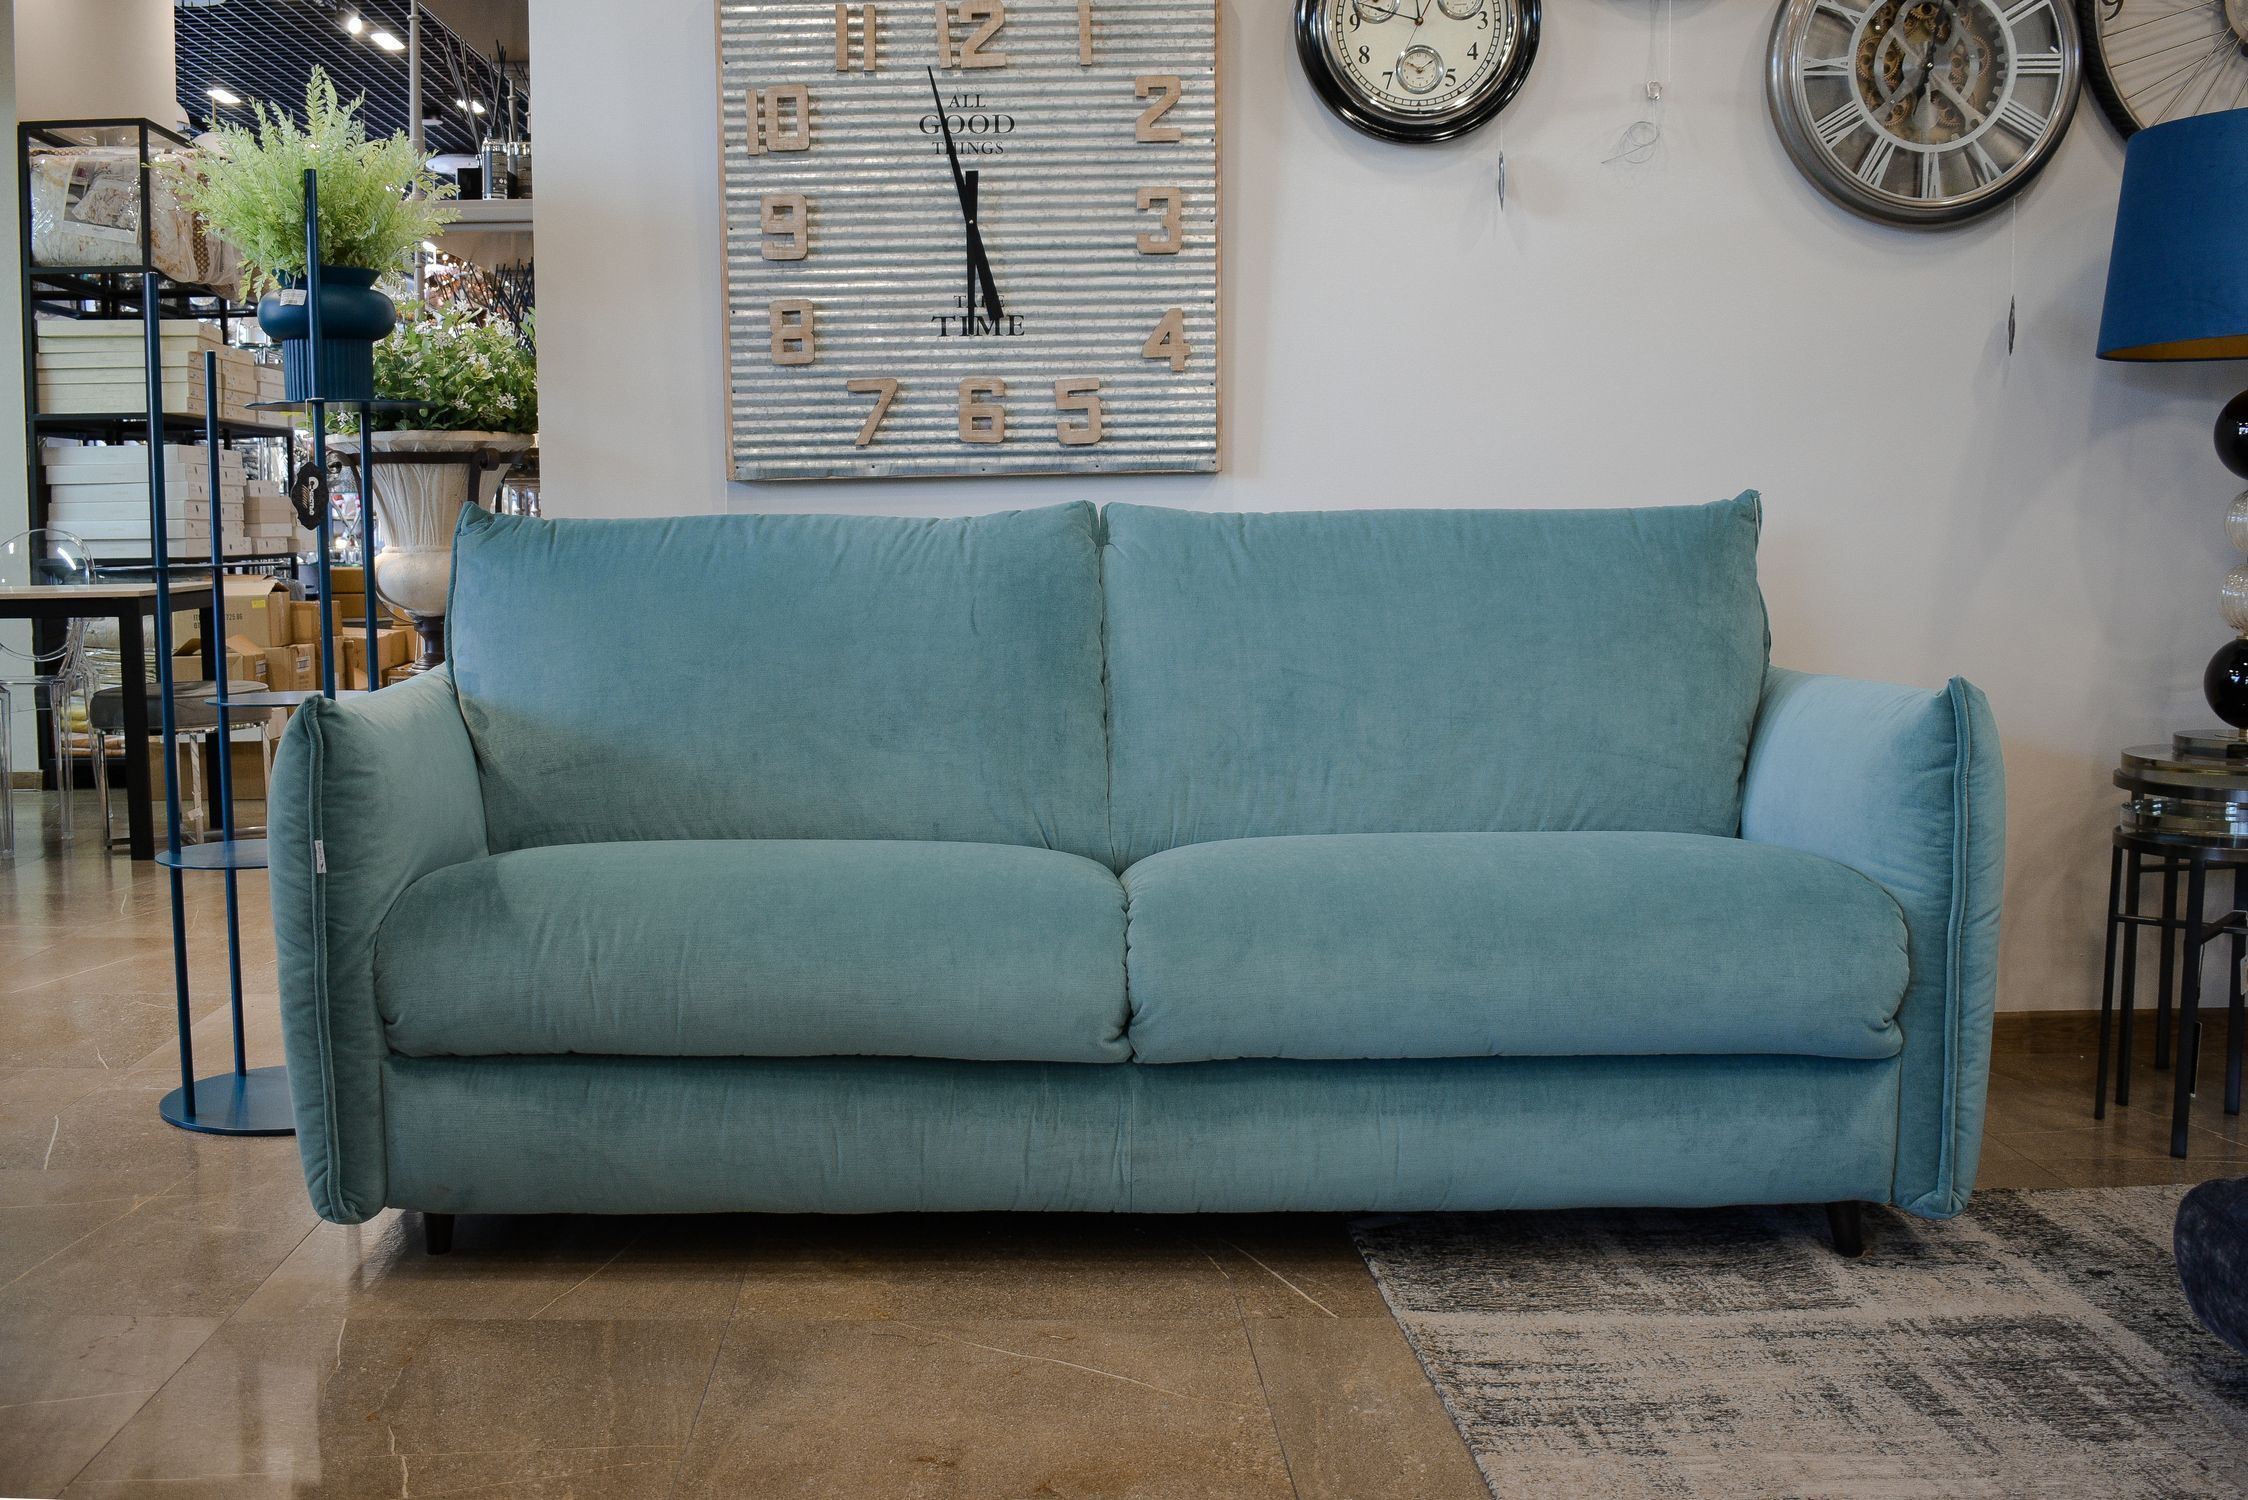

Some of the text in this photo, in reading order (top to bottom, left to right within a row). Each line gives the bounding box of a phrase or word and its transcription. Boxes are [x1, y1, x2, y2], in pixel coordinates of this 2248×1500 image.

[836, 4, 876, 71] 11
[935, 0, 1006, 68] 12
[1467, 42, 1478, 60] 4
[1477, 11, 1488, 29] 3
[1359, 45, 1370, 64] 8
[1382, 72, 1394, 90] 7
[1445, 68, 1456, 87] 5
[746, 85, 810, 156] 10
[919, 114, 1015, 135] GOOD
[948, 93, 986, 108] ALL
[1135, 75, 1181, 142] 2
[761, 193, 808, 261] 9
[1136, 186, 1182, 254] 3
[769, 299, 815, 365] 8
[931, 315, 1025, 337] TIME
[954, 295, 1005, 308] TE
[1141, 308, 1191, 372] 4
[847, 378, 898, 446] 7
[959, 377, 1006, 443] 6
[1055, 377, 1101, 444] 5
